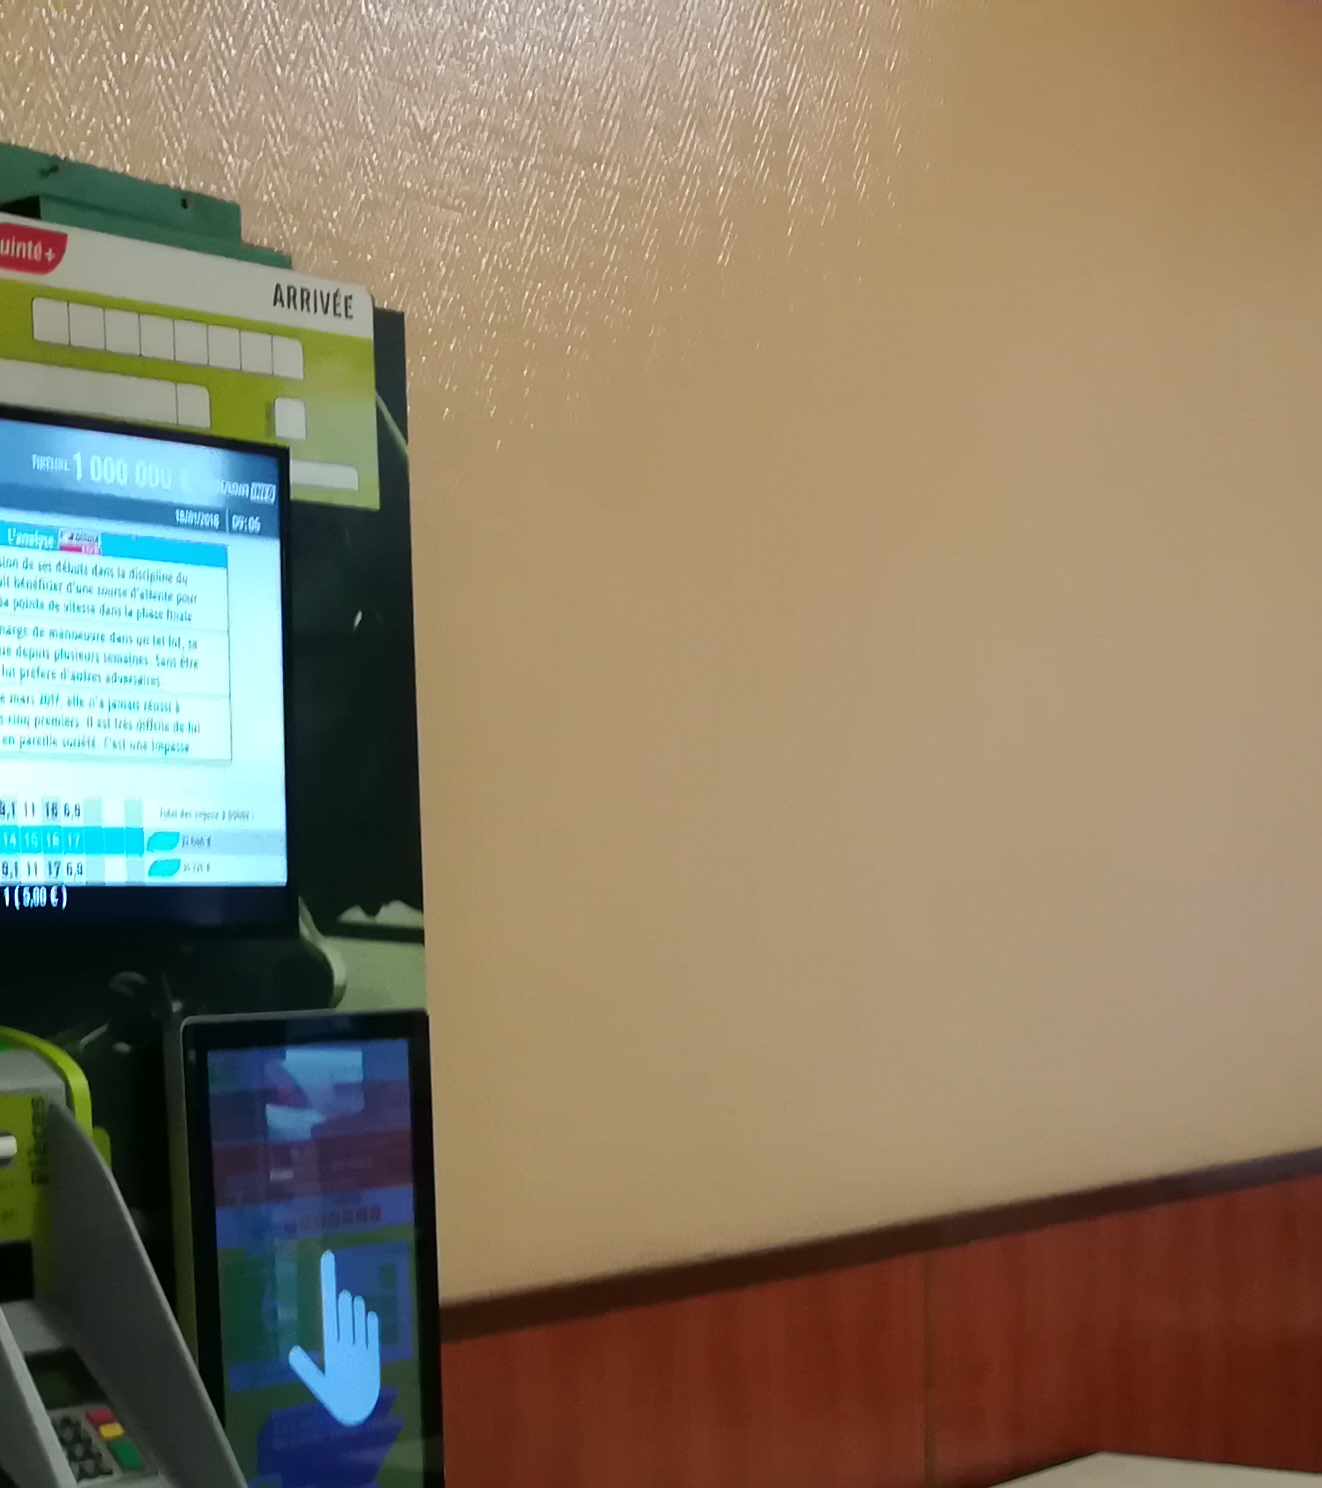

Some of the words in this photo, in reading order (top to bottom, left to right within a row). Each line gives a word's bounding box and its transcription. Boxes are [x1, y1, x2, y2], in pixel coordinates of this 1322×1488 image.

[273, 283, 354, 320] ARRIVÉE
[73, 451, 82, 480] 1
[3, 831, 17, 846] 14
[24, 831, 38, 847] 15
[46, 832, 59, 847] 16
[67, 832, 80, 849] 17
